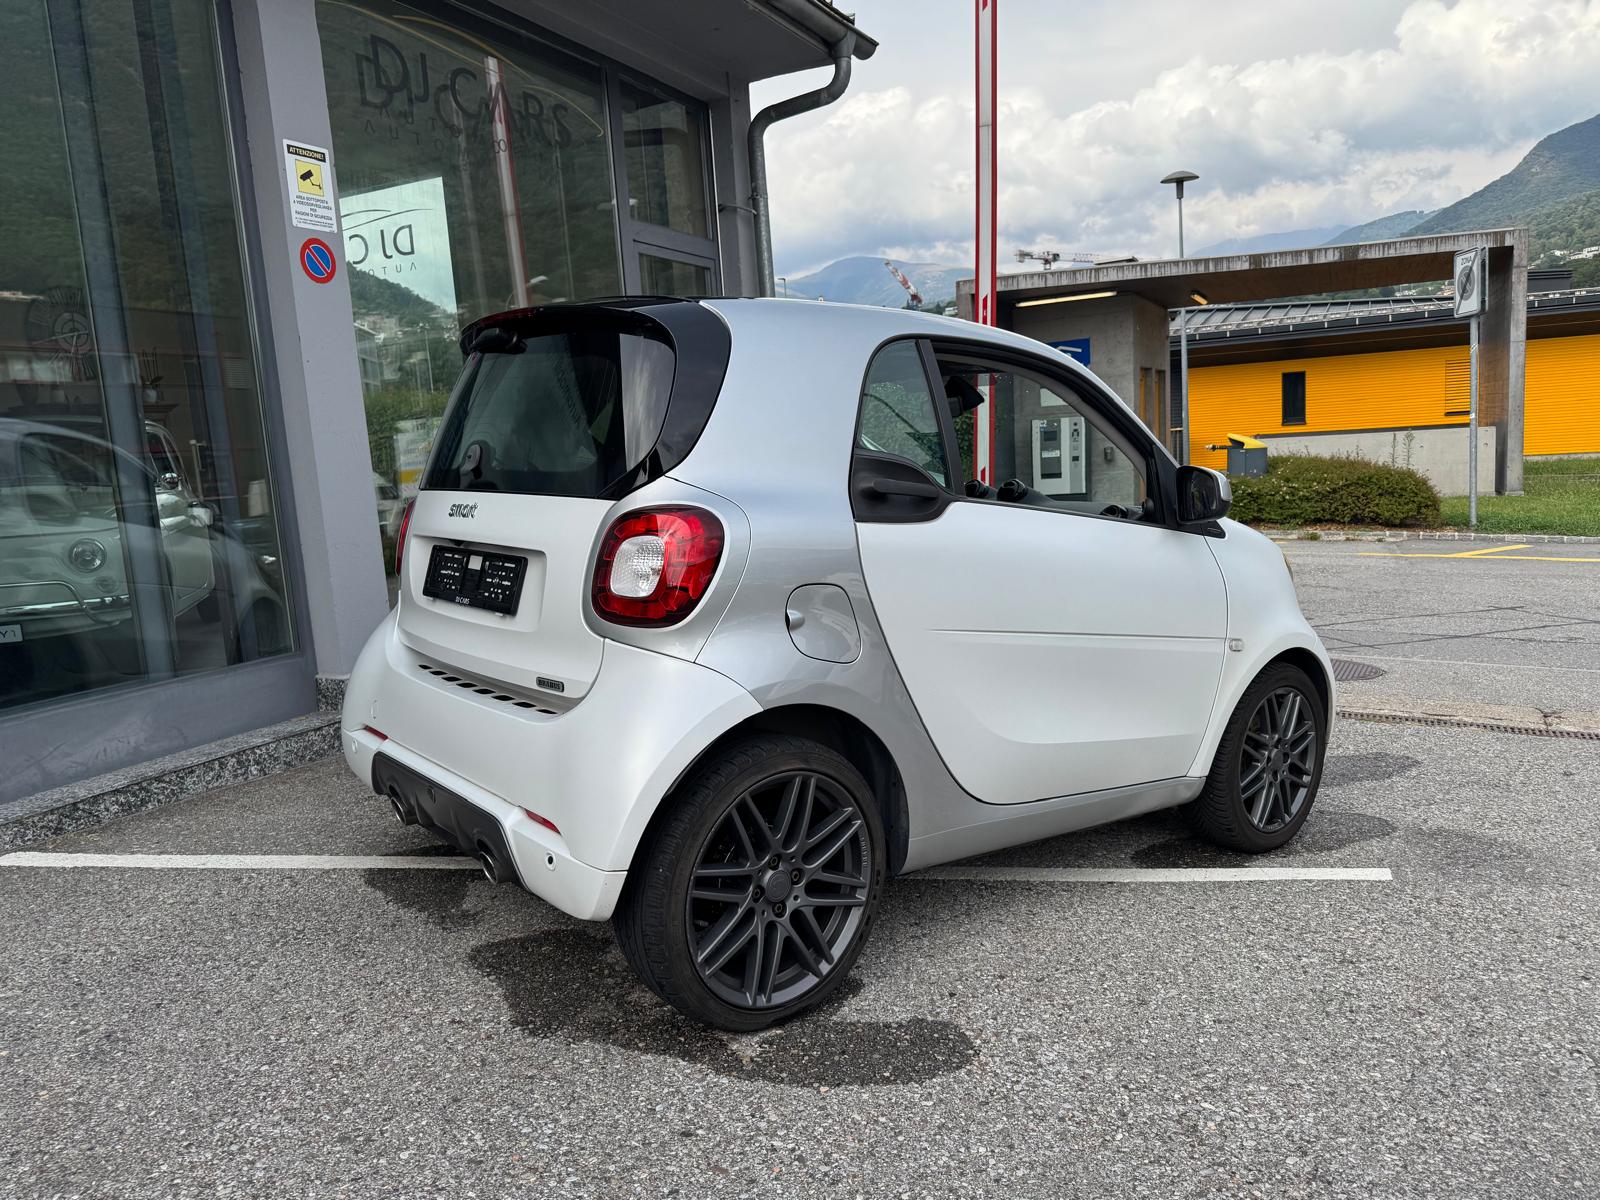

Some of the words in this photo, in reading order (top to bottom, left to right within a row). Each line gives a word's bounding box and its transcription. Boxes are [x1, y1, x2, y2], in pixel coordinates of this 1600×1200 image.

[450, 67, 571, 148] CARS
[288, 146, 324, 160] ATTENZIONE!
[448, 501, 479, 519] smart
[537, 679, 561, 691] BRABUS
